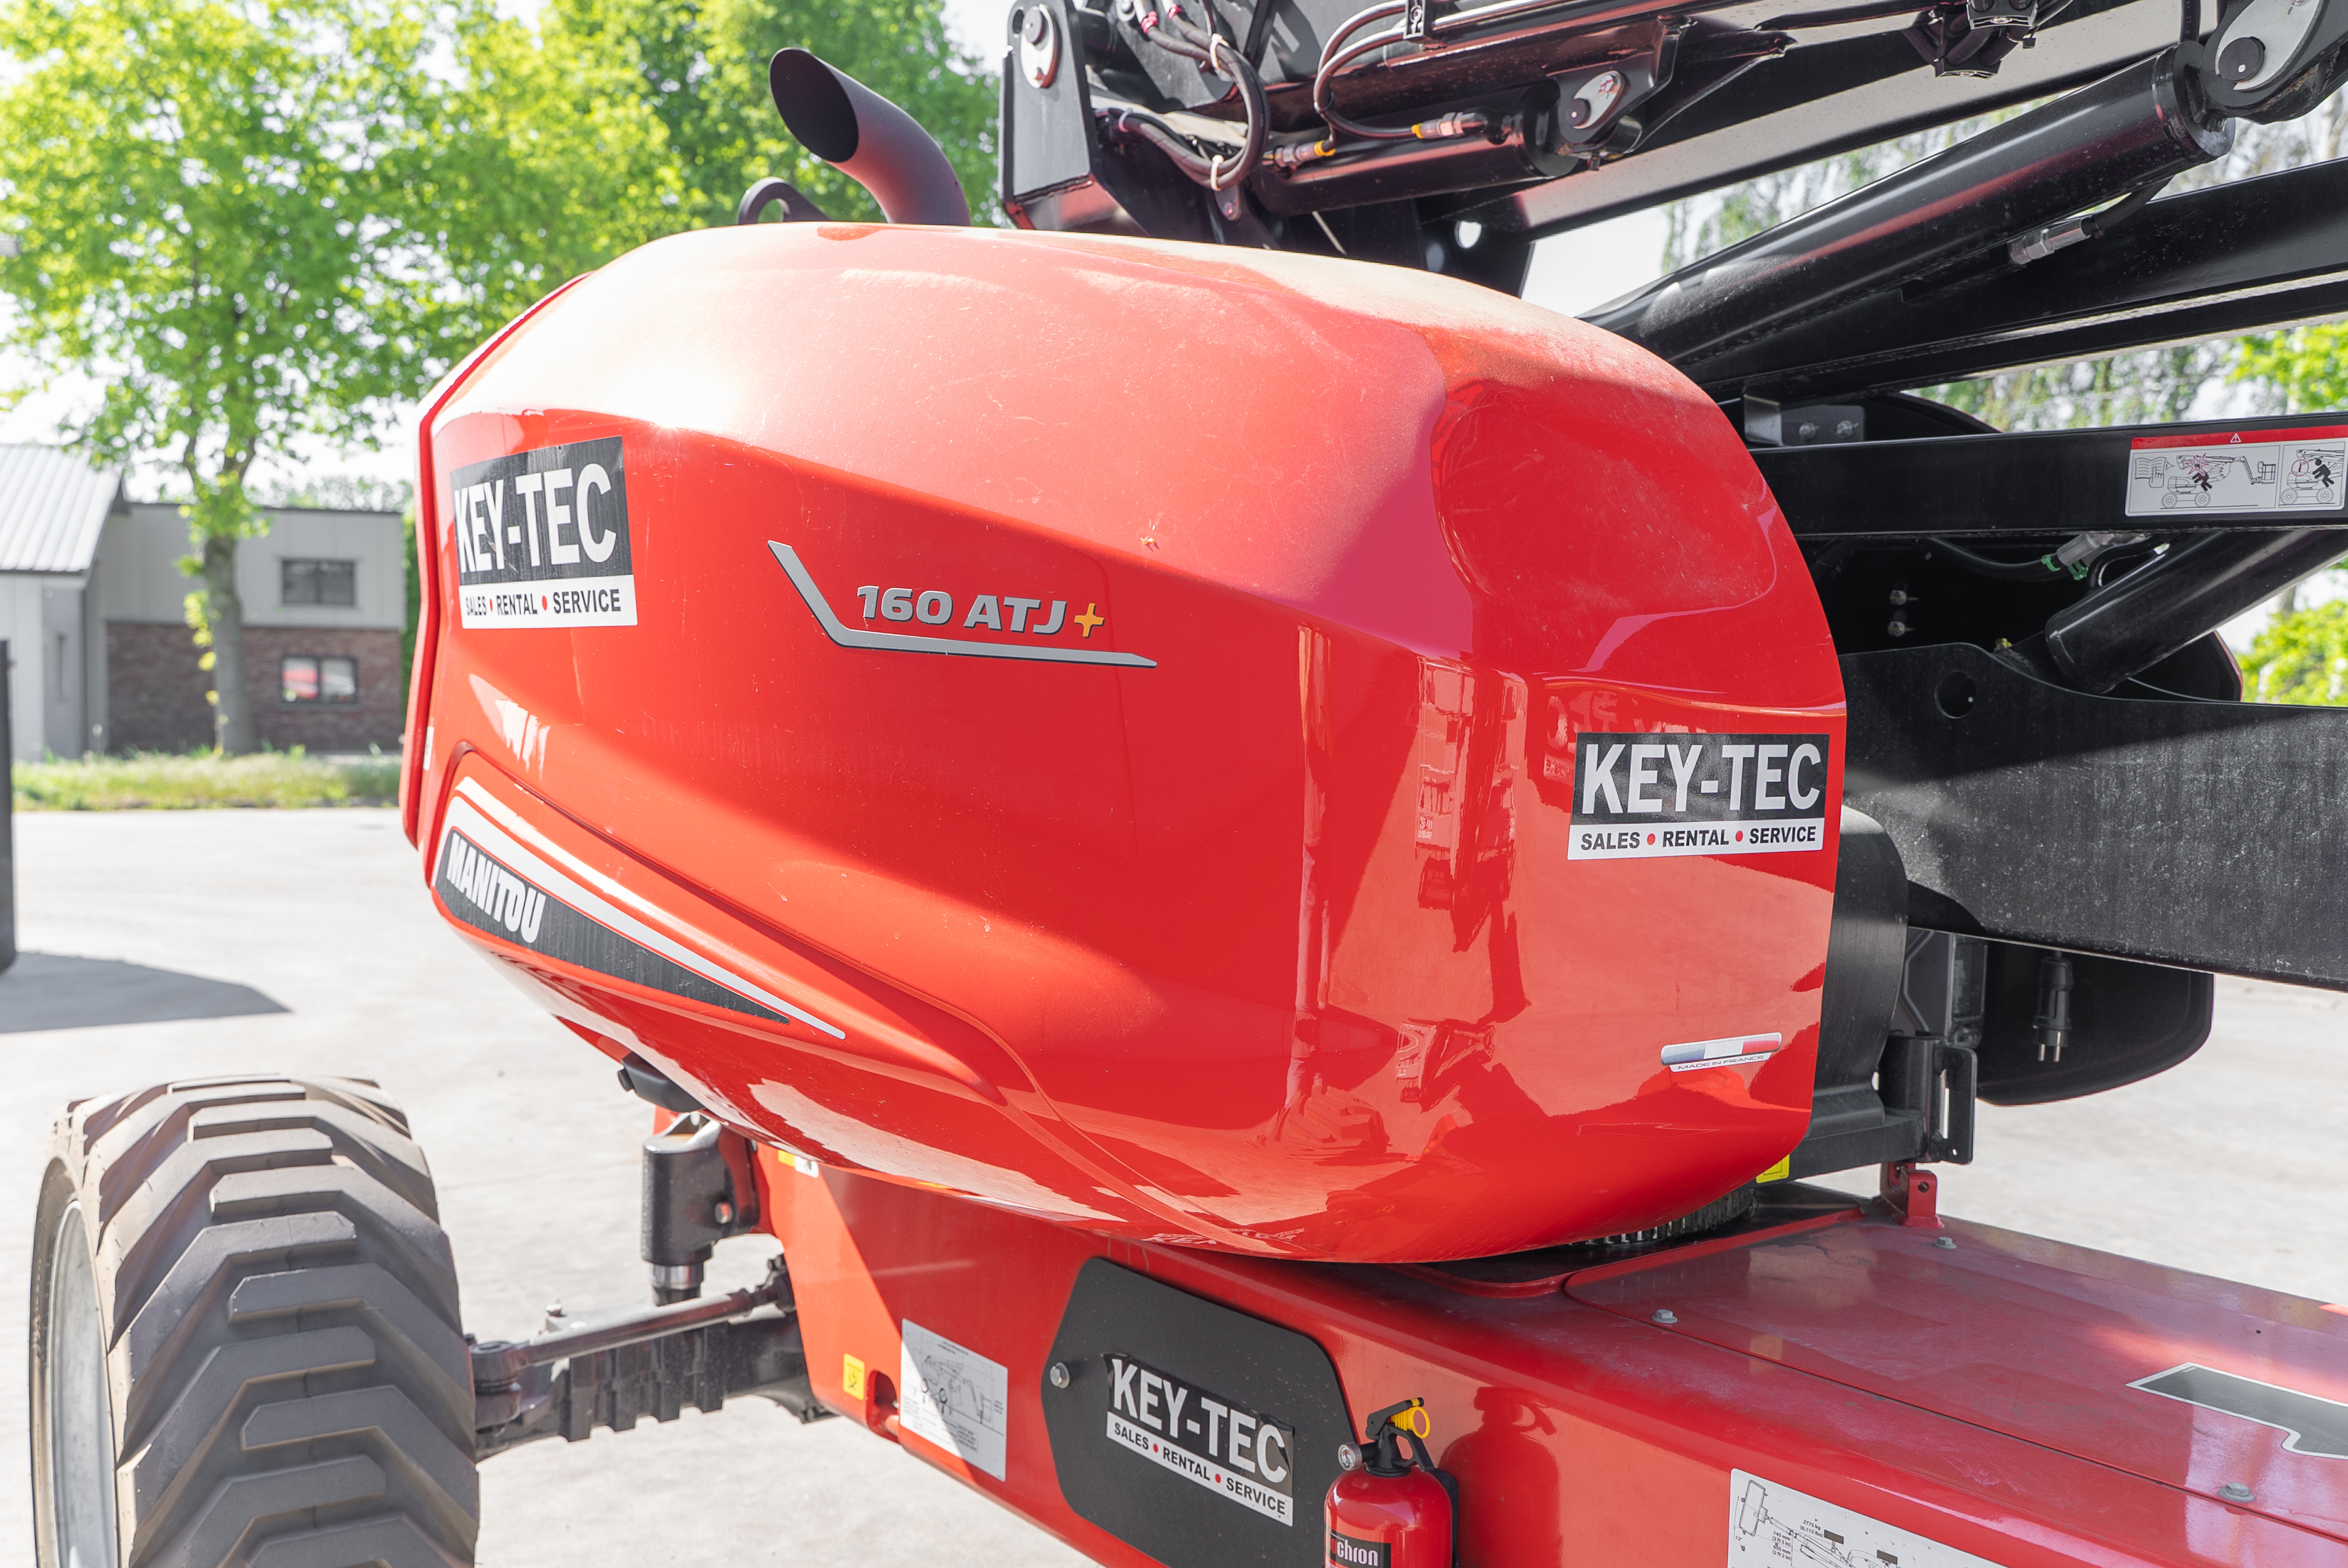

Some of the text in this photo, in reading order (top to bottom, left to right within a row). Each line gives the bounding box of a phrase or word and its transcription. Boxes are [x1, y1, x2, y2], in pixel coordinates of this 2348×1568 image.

[454, 464, 617, 573] KEY-TEC
[465, 589, 622, 616] SALES RENTAL SERVICE
[857, 585, 954, 625] 160
[1582, 743, 1822, 814] KEY-TEC
[1580, 826, 1817, 851] SALES RENTAL SERVICE
[446, 832, 547, 944] MANITOU
[1678, 1061, 1710, 1071] MADE
[1723, 1055, 1764, 1064] FRANCE
[1111, 1358, 1287, 1484] KEY-TEC
[1114, 1422, 1285, 1516] SALES RENTAL SERVICE
